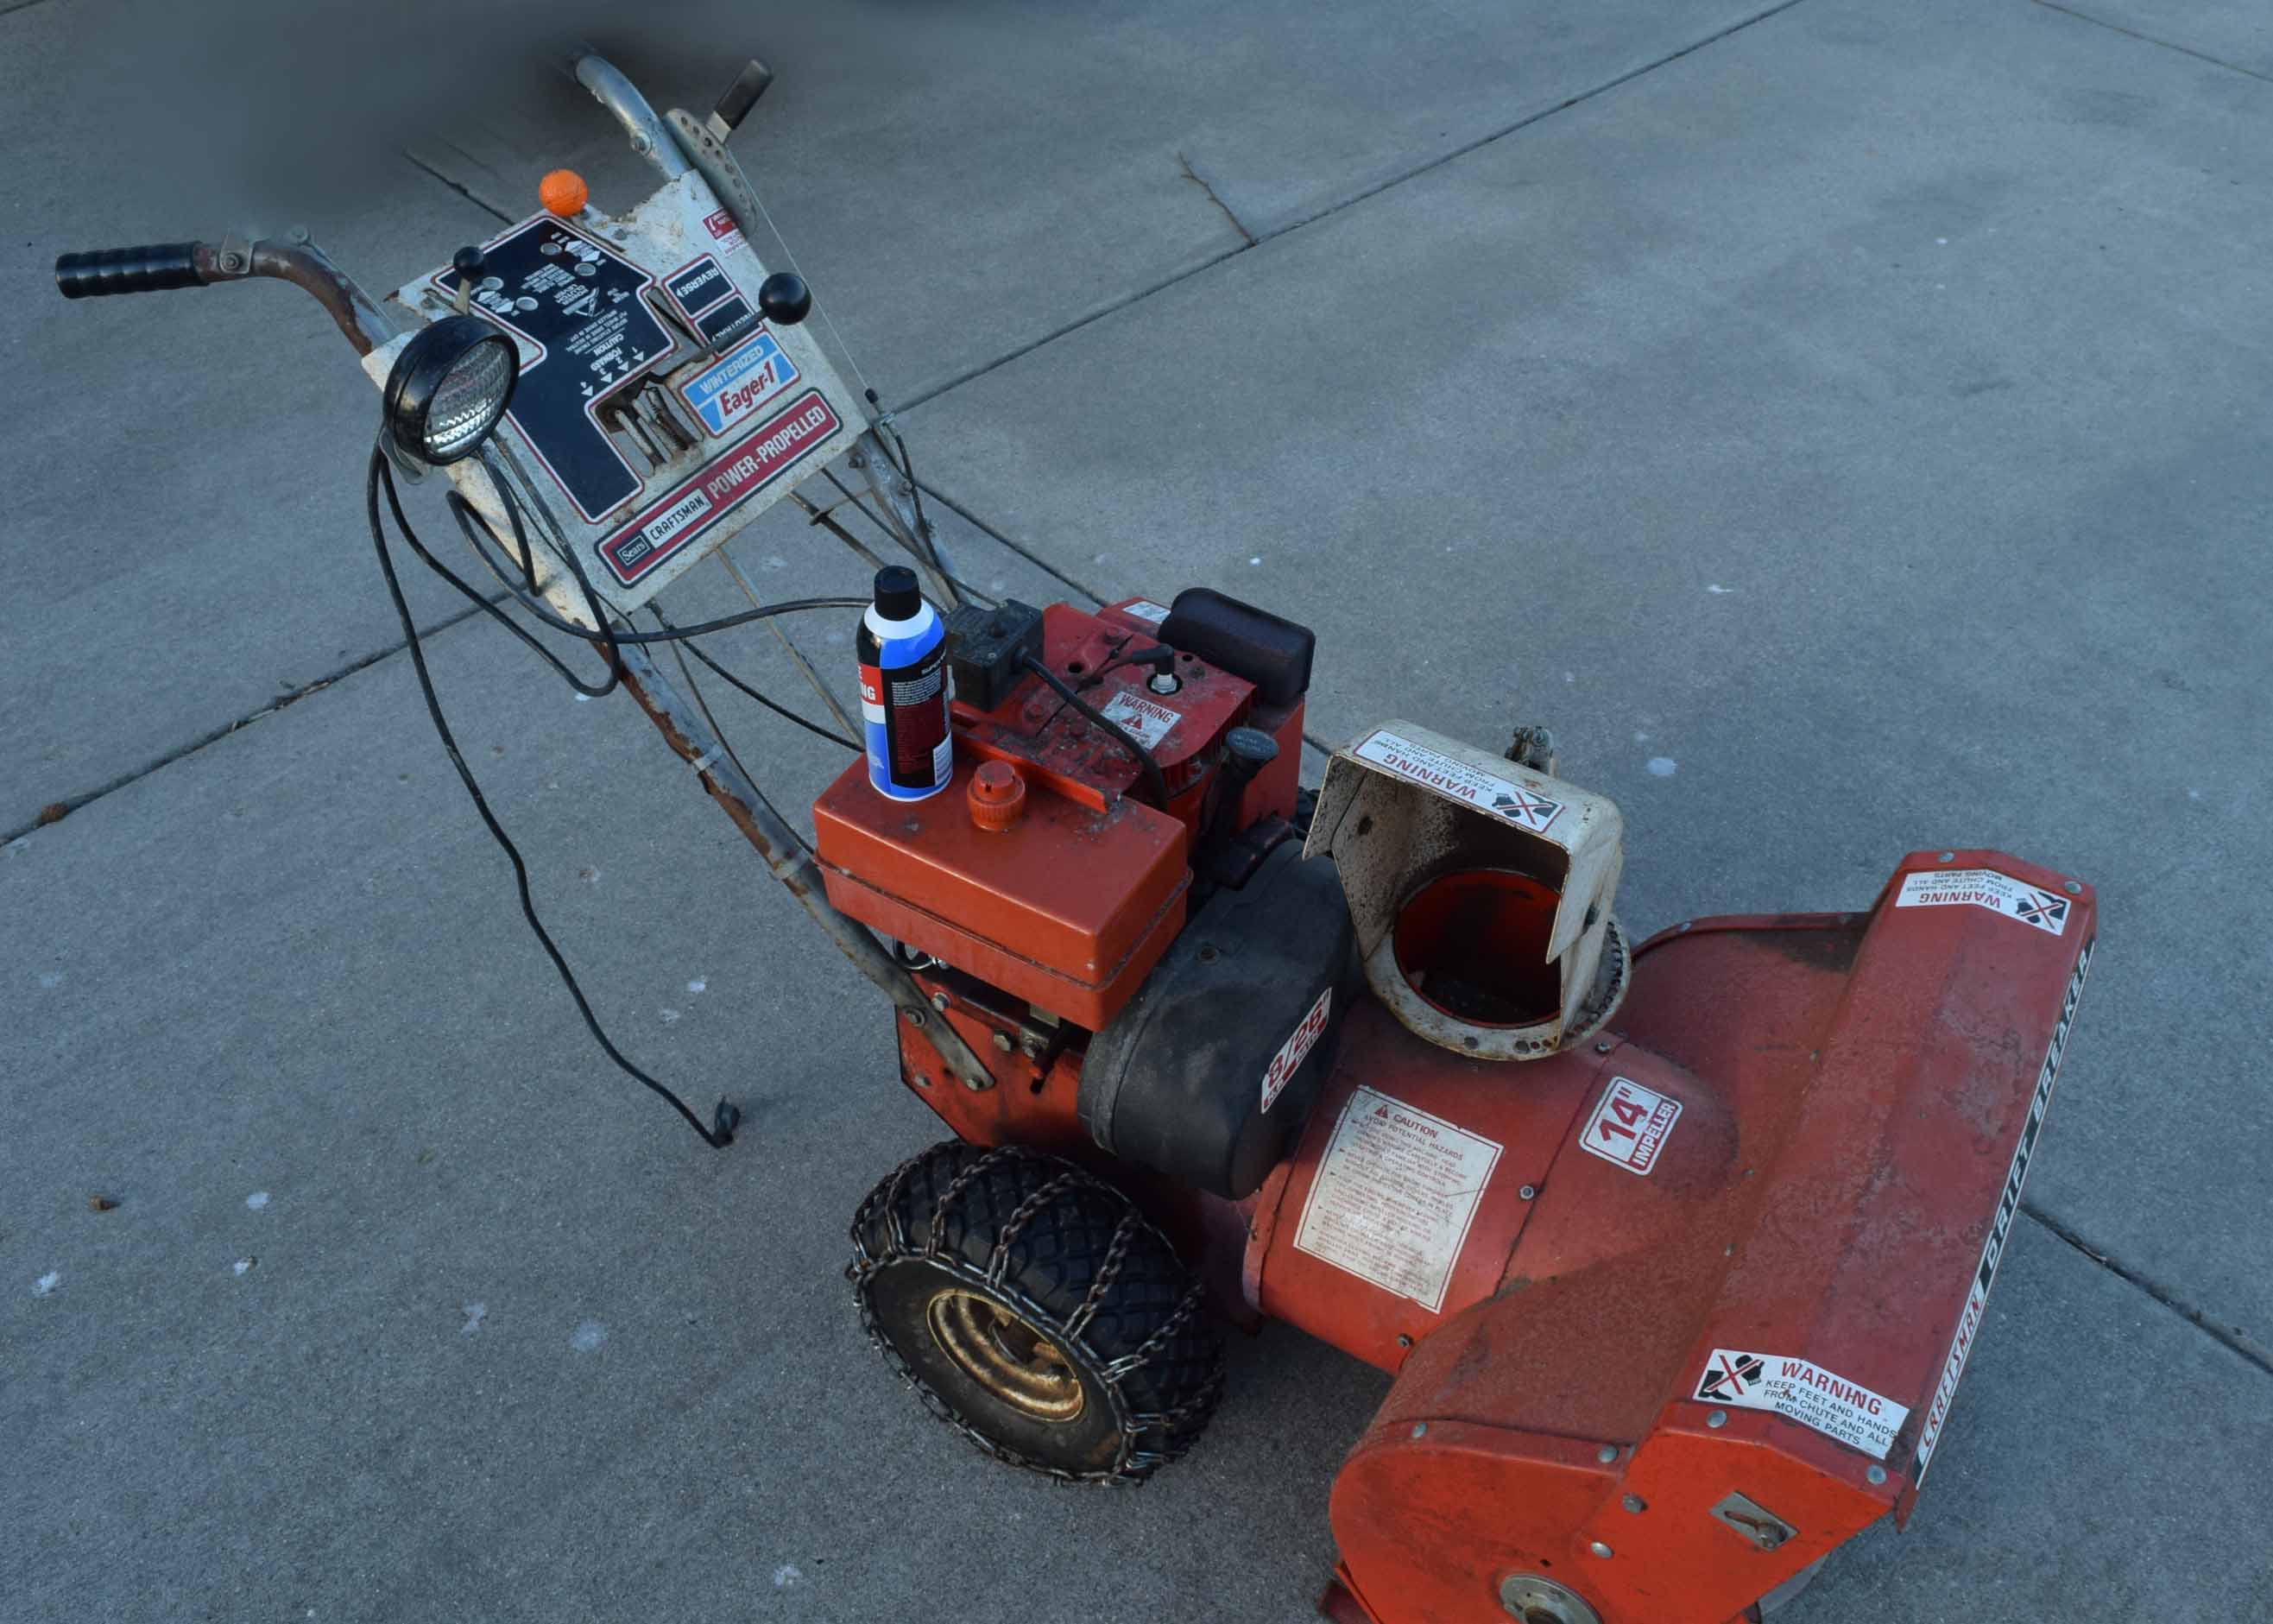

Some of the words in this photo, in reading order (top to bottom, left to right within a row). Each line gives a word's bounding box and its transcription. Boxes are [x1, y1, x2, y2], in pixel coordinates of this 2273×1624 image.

[681, 267, 719, 295] REVERSE
[593, 333, 624, 356] CAUTION
[699, 345, 764, 395] WINTERIZED
[621, 541, 646, 561] Sears
[650, 496, 705, 540] CRAFTSMAN
[707, 405, 827, 500] POWER-PROPELLED
[1119, 693, 1174, 724] WARNING
[1384, 754, 1477, 799] WARNING
[1412, 756, 1435, 768] AND
[1436, 767, 1464, 782] FEET
[1919, 891, 2001, 908] WARNING
[1393, 1114, 1439, 1139] CAUTION
[1600, 1086, 1649, 1141] 14"
[1632, 1102, 1676, 1166] IMPELLER
[1388, 1124, 1426, 1146] POTENTIAL
[1429, 1141, 1464, 1161] HAZARDS
[1923, 1294, 1980, 1448] CRAFTSMAN
[1986, 1136, 2028, 1270] DRIFT
[2033, 949, 2087, 1123] BREAKER
[1765, 1379, 1796, 1389] KEEP
[1798, 1386, 1828, 1406] FEET
[1829, 1402, 1853, 1418] AND
[1857, 1415, 1897, 1438] HANDS
[1781, 1362, 1882, 1416] WARNING
[1764, 1389, 1797, 1403] FROM
[1799, 1399, 1838, 1423] CHUTE
[1840, 1419, 1865, 1435] AND
[1866, 1431, 1889, 1447] ALL
[1774, 1401, 1821, 1426] MOVING
[1824, 1422, 1860, 1445] PARTS
